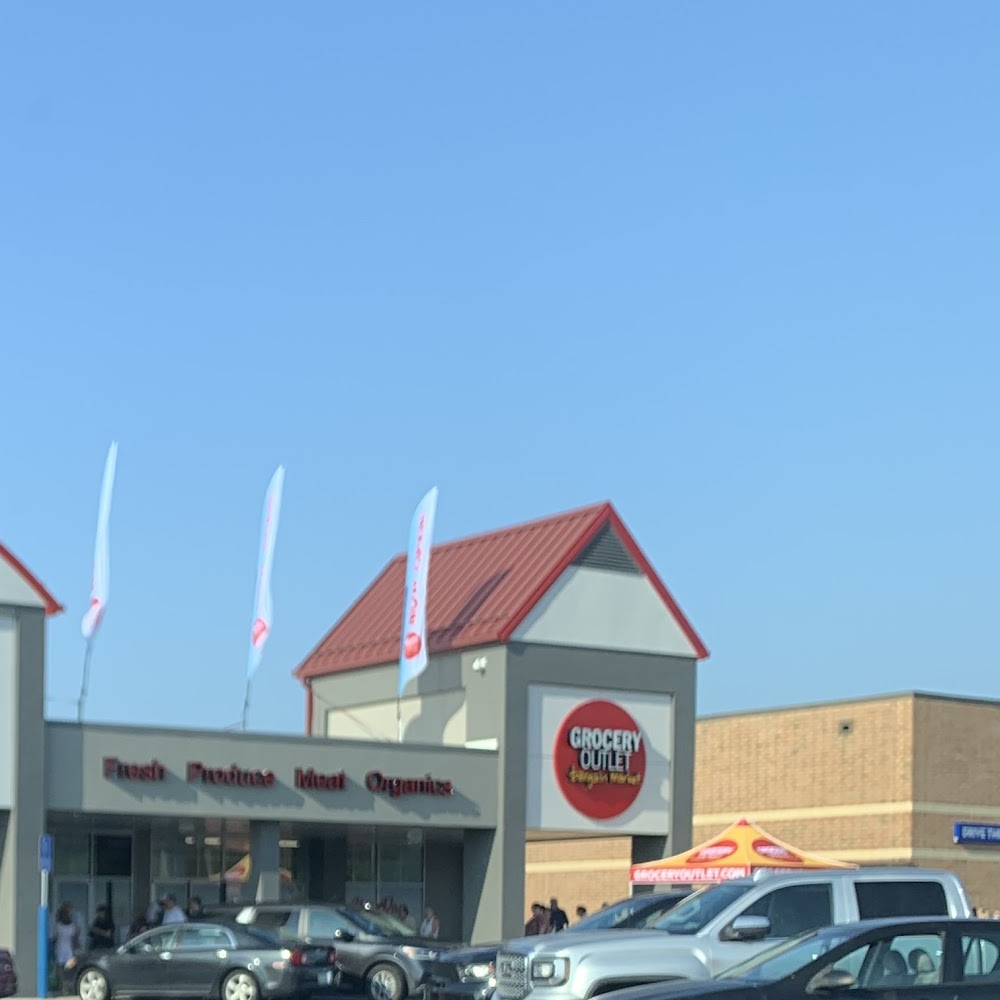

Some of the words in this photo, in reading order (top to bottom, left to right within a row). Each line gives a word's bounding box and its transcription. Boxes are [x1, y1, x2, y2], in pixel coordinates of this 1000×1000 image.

[570, 726, 641, 752] GROCERY
[580, 749, 632, 772] OUTLET
[103, 757, 166, 782] Fresh
[187, 761, 276, 789] Produce
[294, 766, 347, 791] Meat
